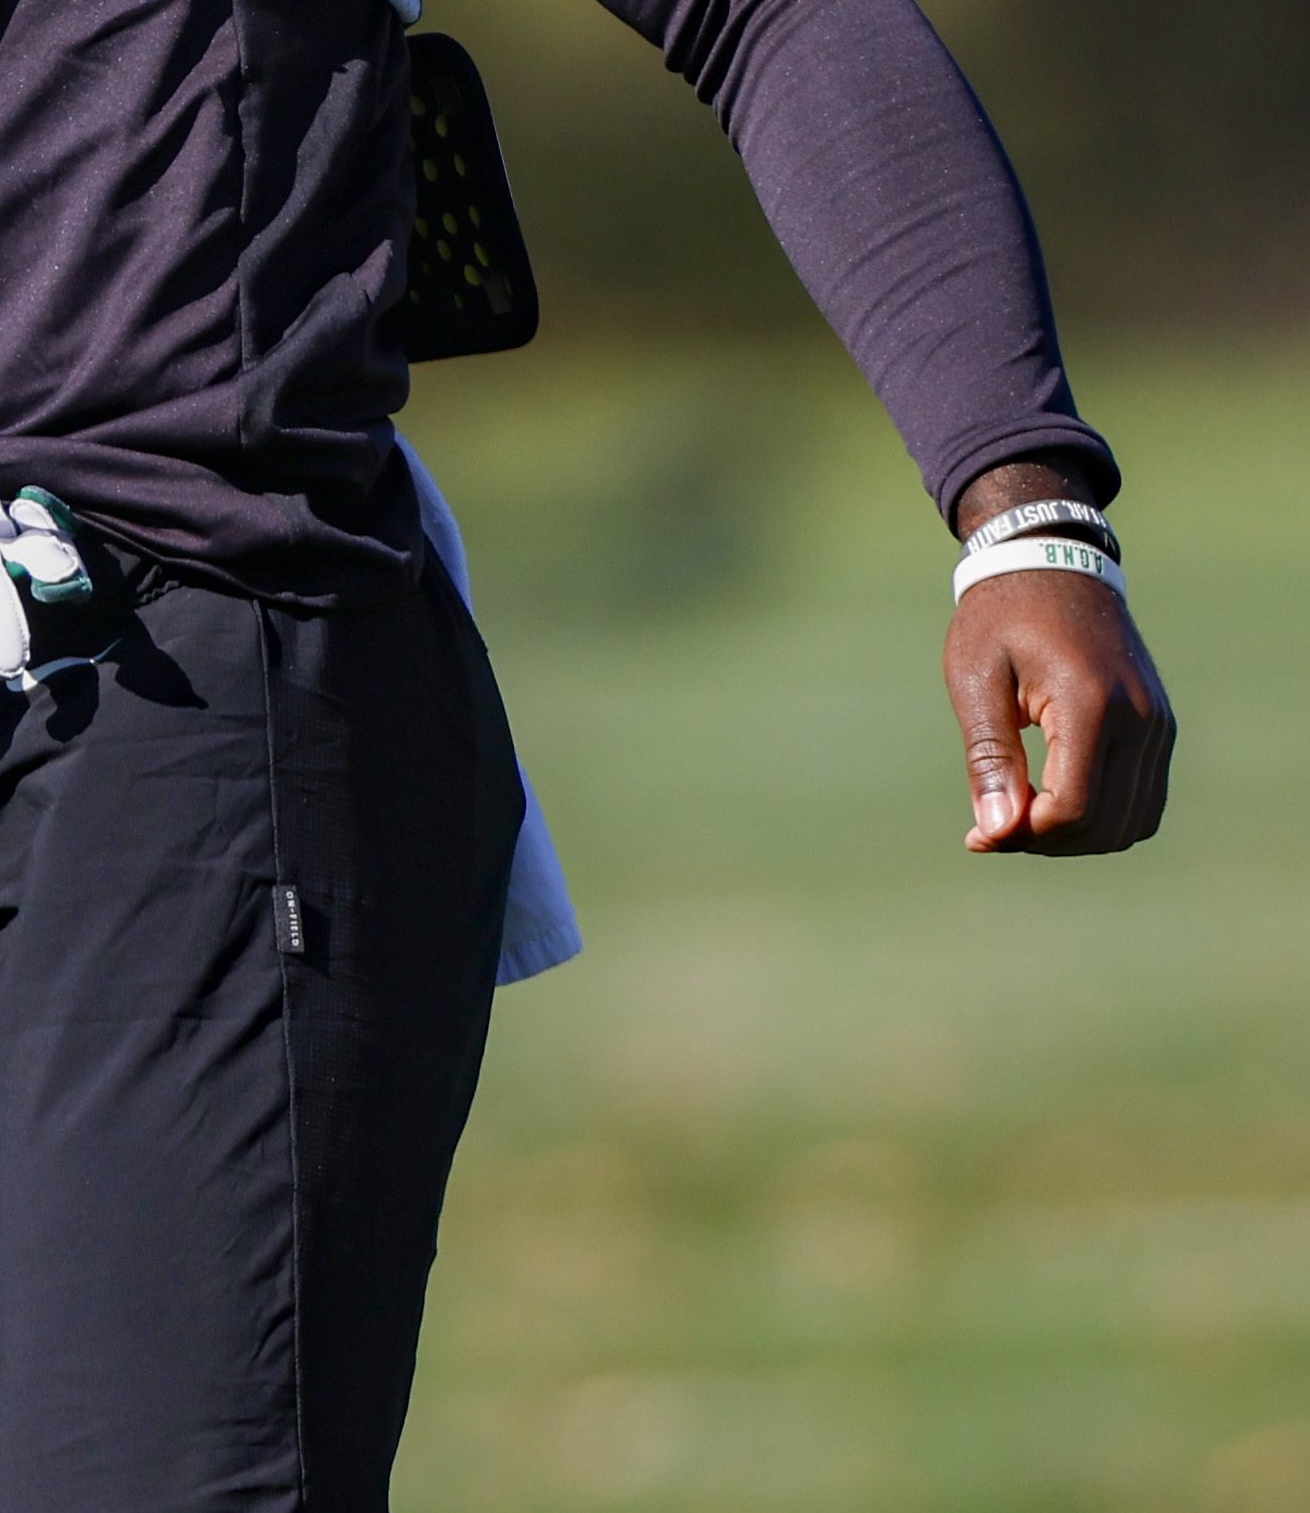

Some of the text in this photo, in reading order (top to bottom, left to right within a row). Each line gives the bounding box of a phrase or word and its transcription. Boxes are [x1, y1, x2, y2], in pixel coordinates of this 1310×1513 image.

[966, 513, 1014, 554] FAITH
[1014, 501, 1058, 529] JUST
[285, 890, 300, 947] ON-FIELD
